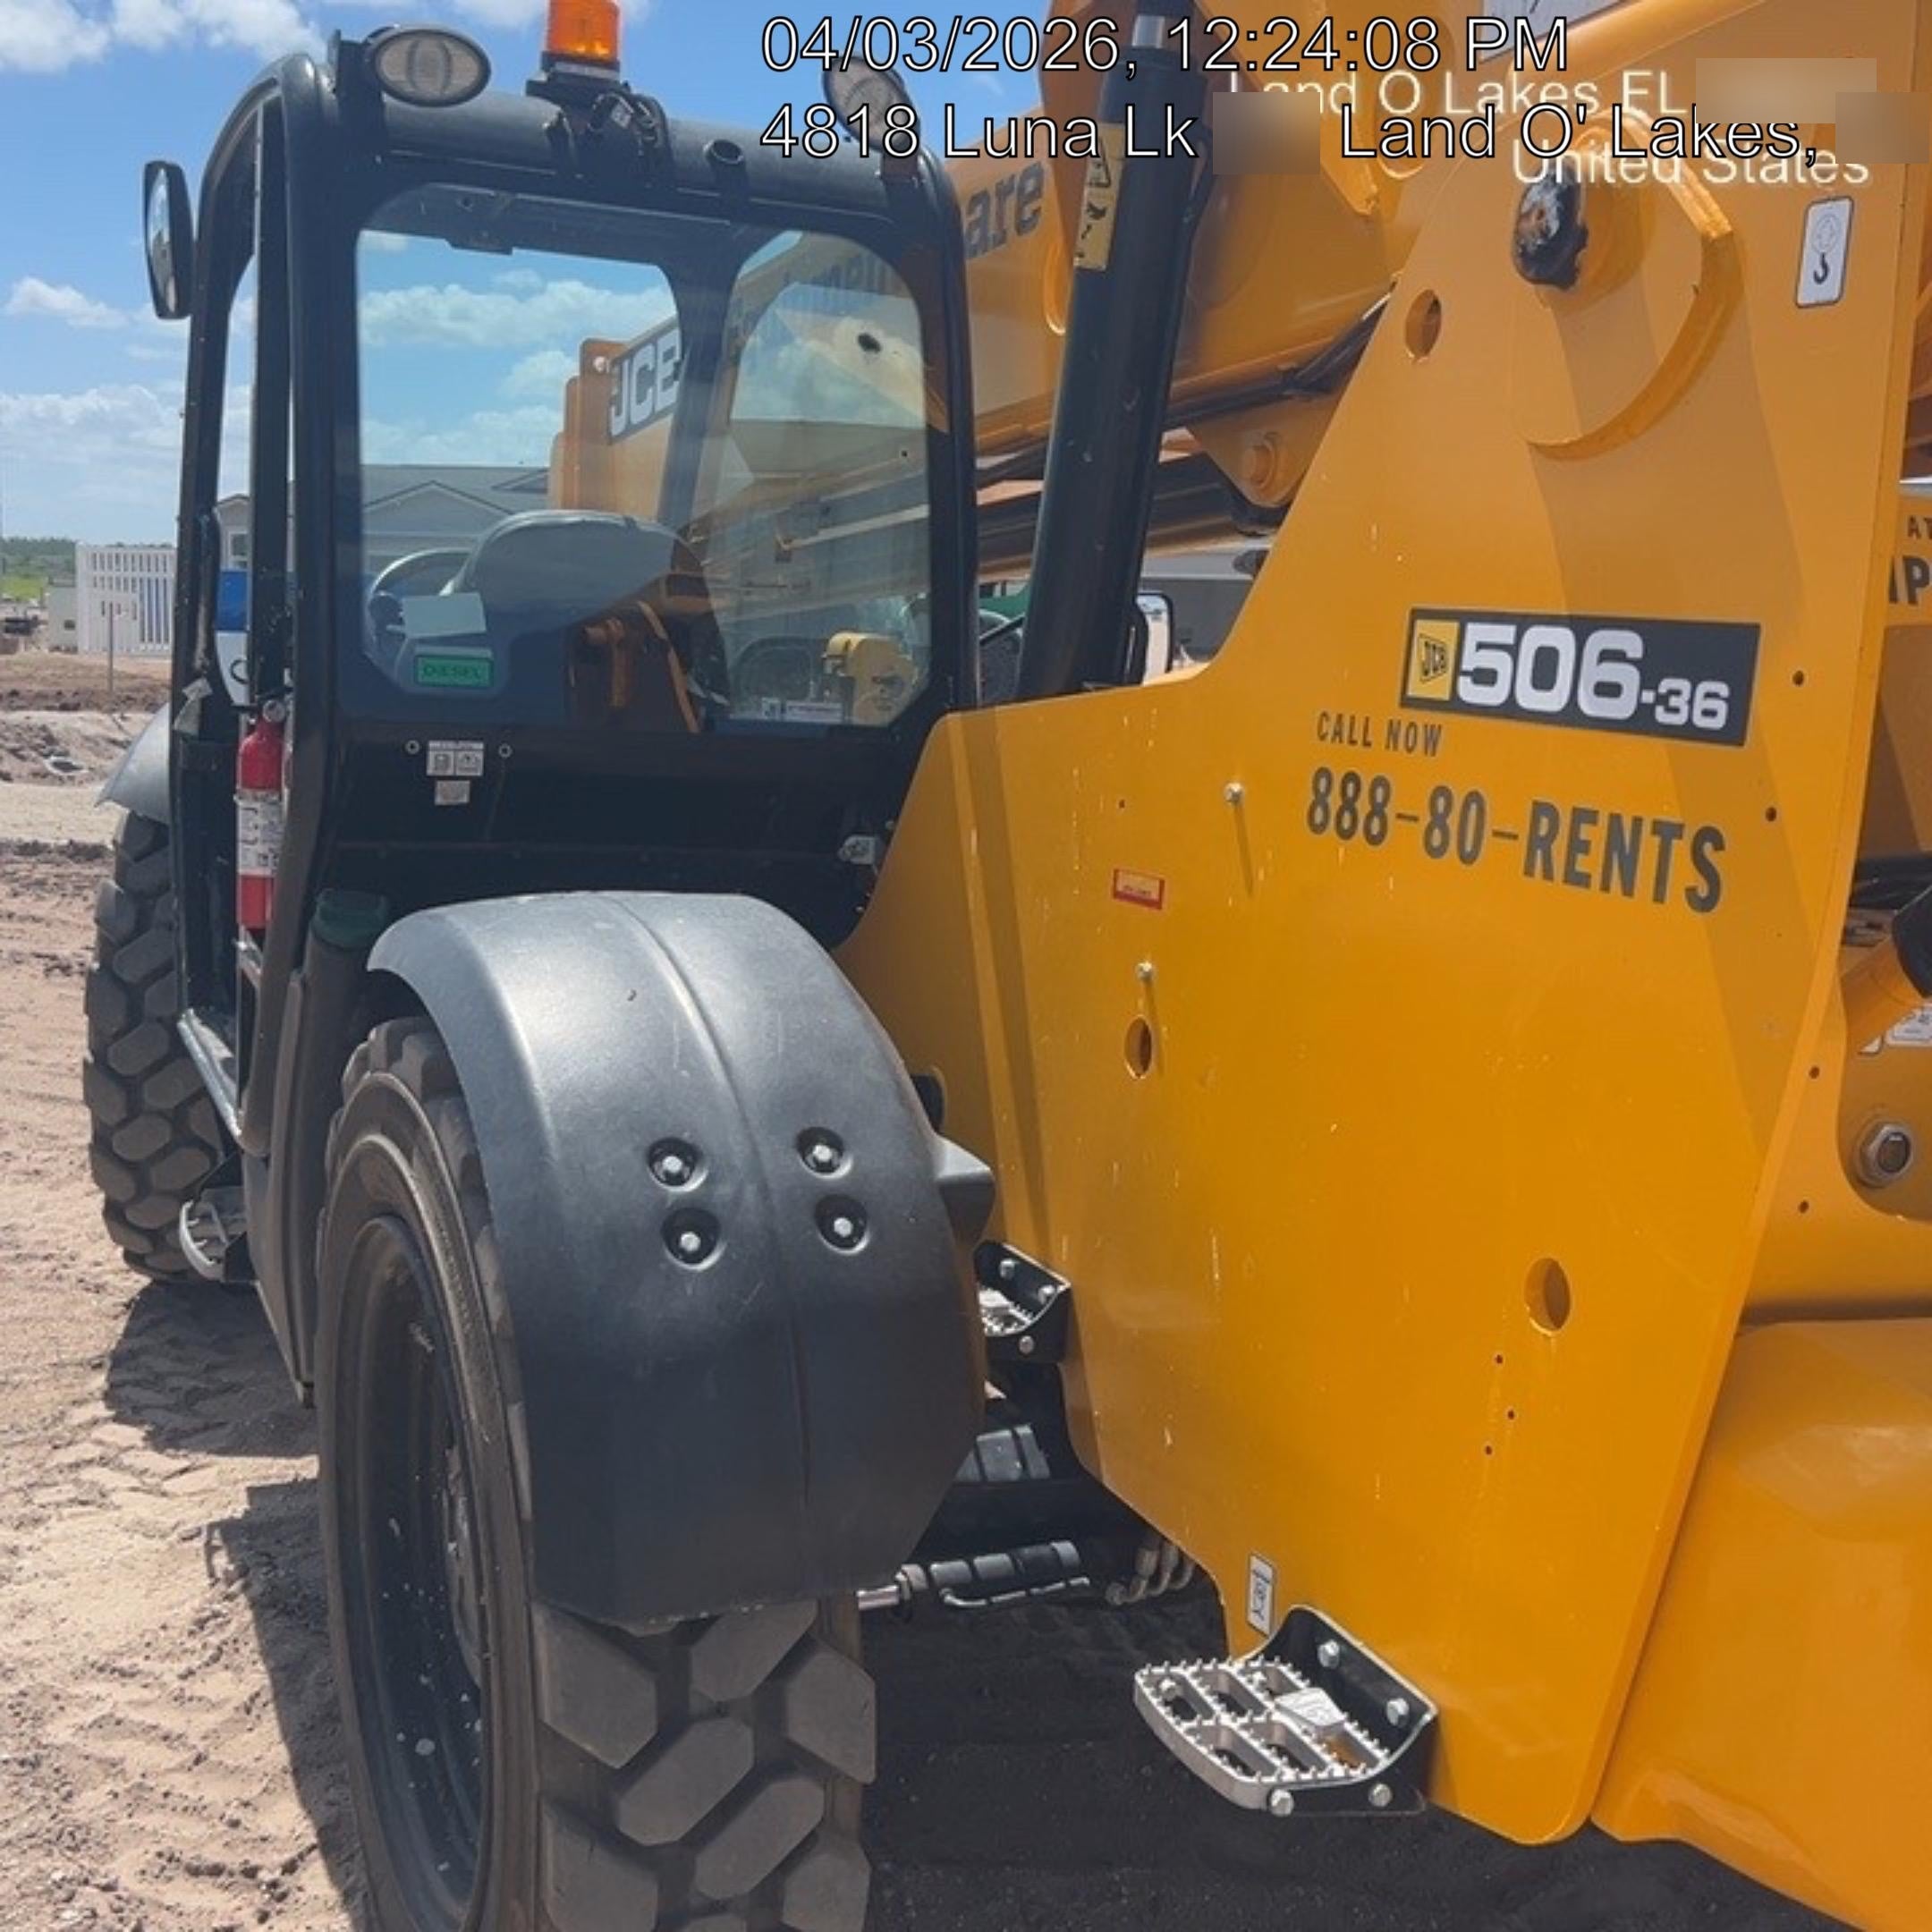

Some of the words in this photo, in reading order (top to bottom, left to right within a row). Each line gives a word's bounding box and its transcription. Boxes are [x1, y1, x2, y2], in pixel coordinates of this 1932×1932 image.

[1456, 622, 1730, 731] 506-36
[1317, 711, 1372, 748] CALL
[1385, 718, 1442, 758] NOW
[1307, 766, 1725, 913] 888-80-RENTS
